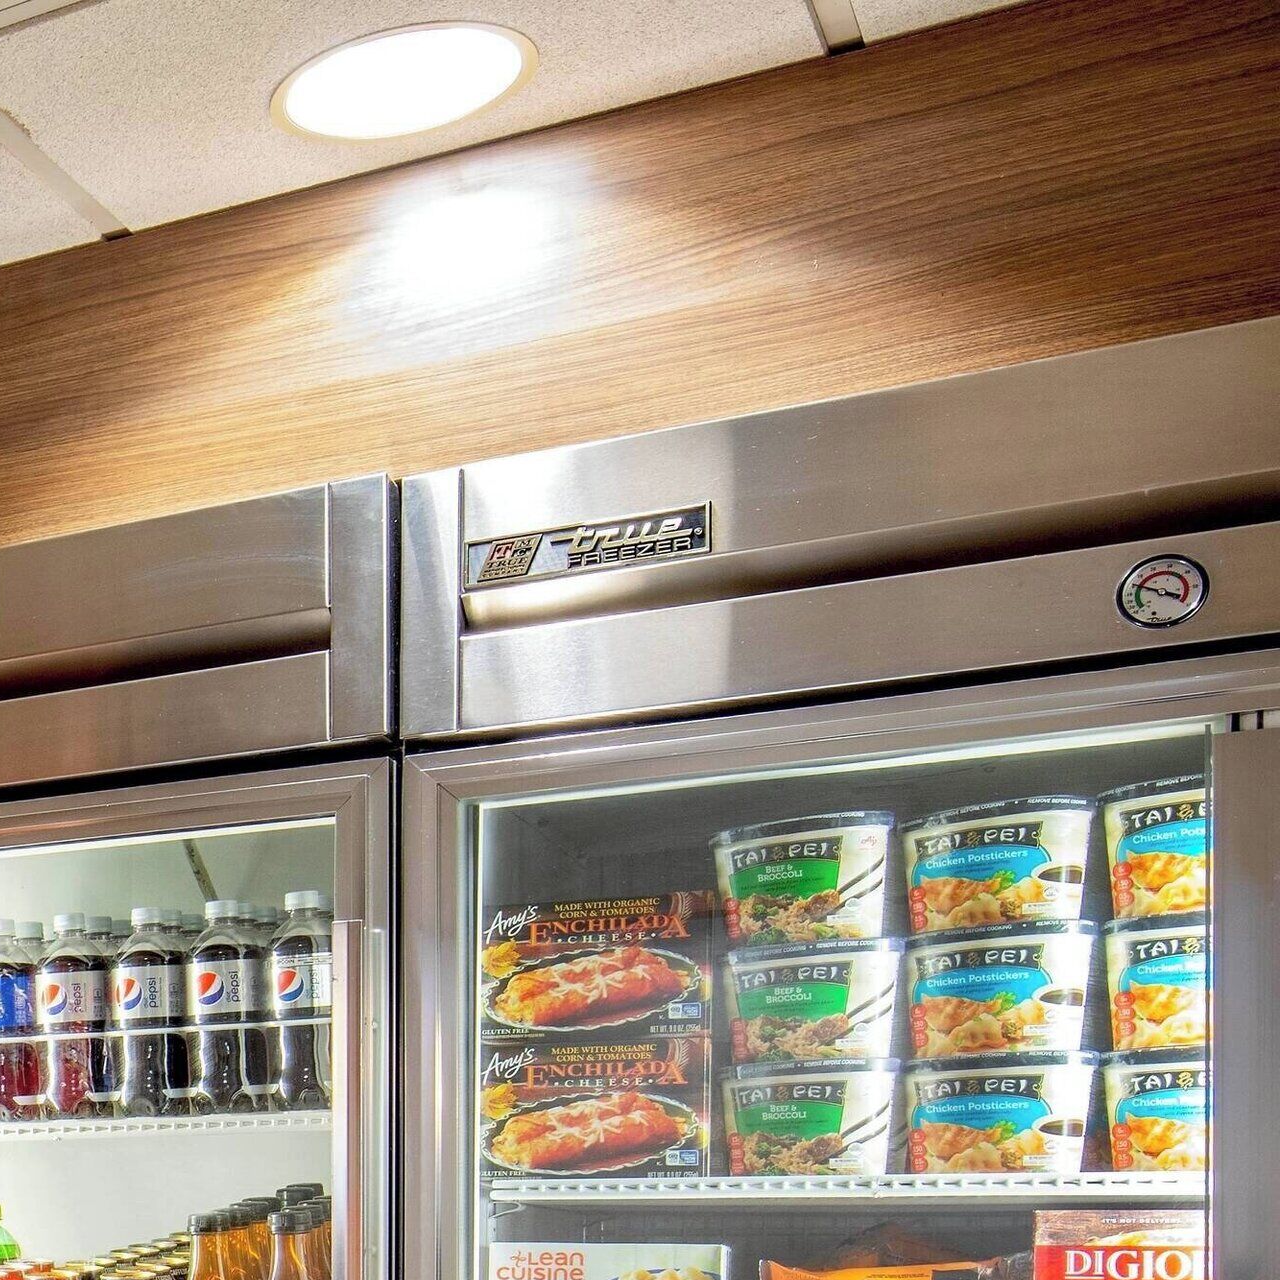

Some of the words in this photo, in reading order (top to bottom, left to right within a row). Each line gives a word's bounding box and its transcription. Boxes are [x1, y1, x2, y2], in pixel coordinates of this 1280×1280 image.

[568, 538, 691, 568] FREEZER
[734, 848, 766, 868] TAI
[789, 842, 827, 857] PEI
[926, 855, 965, 868] Chicken
[968, 848, 1028, 863] Potstickers
[758, 870, 803, 882] BROCCOLI
[554, 903, 583, 911] MADE
[585, 901, 610, 910] WITH
[612, 898, 659, 907] ORGANIC
[560, 910, 586, 918] CORN
[588, 909, 598, 917] &
[600, 906, 654, 916] TOMATOES
[485, 905, 538, 943] Amy's
[528, 915, 690, 946] ENCHILADA
[567, 932, 646, 943] CHEESE
[149, 977, 158, 1008] pepsi
[231, 970, 241, 1003] pepsi
